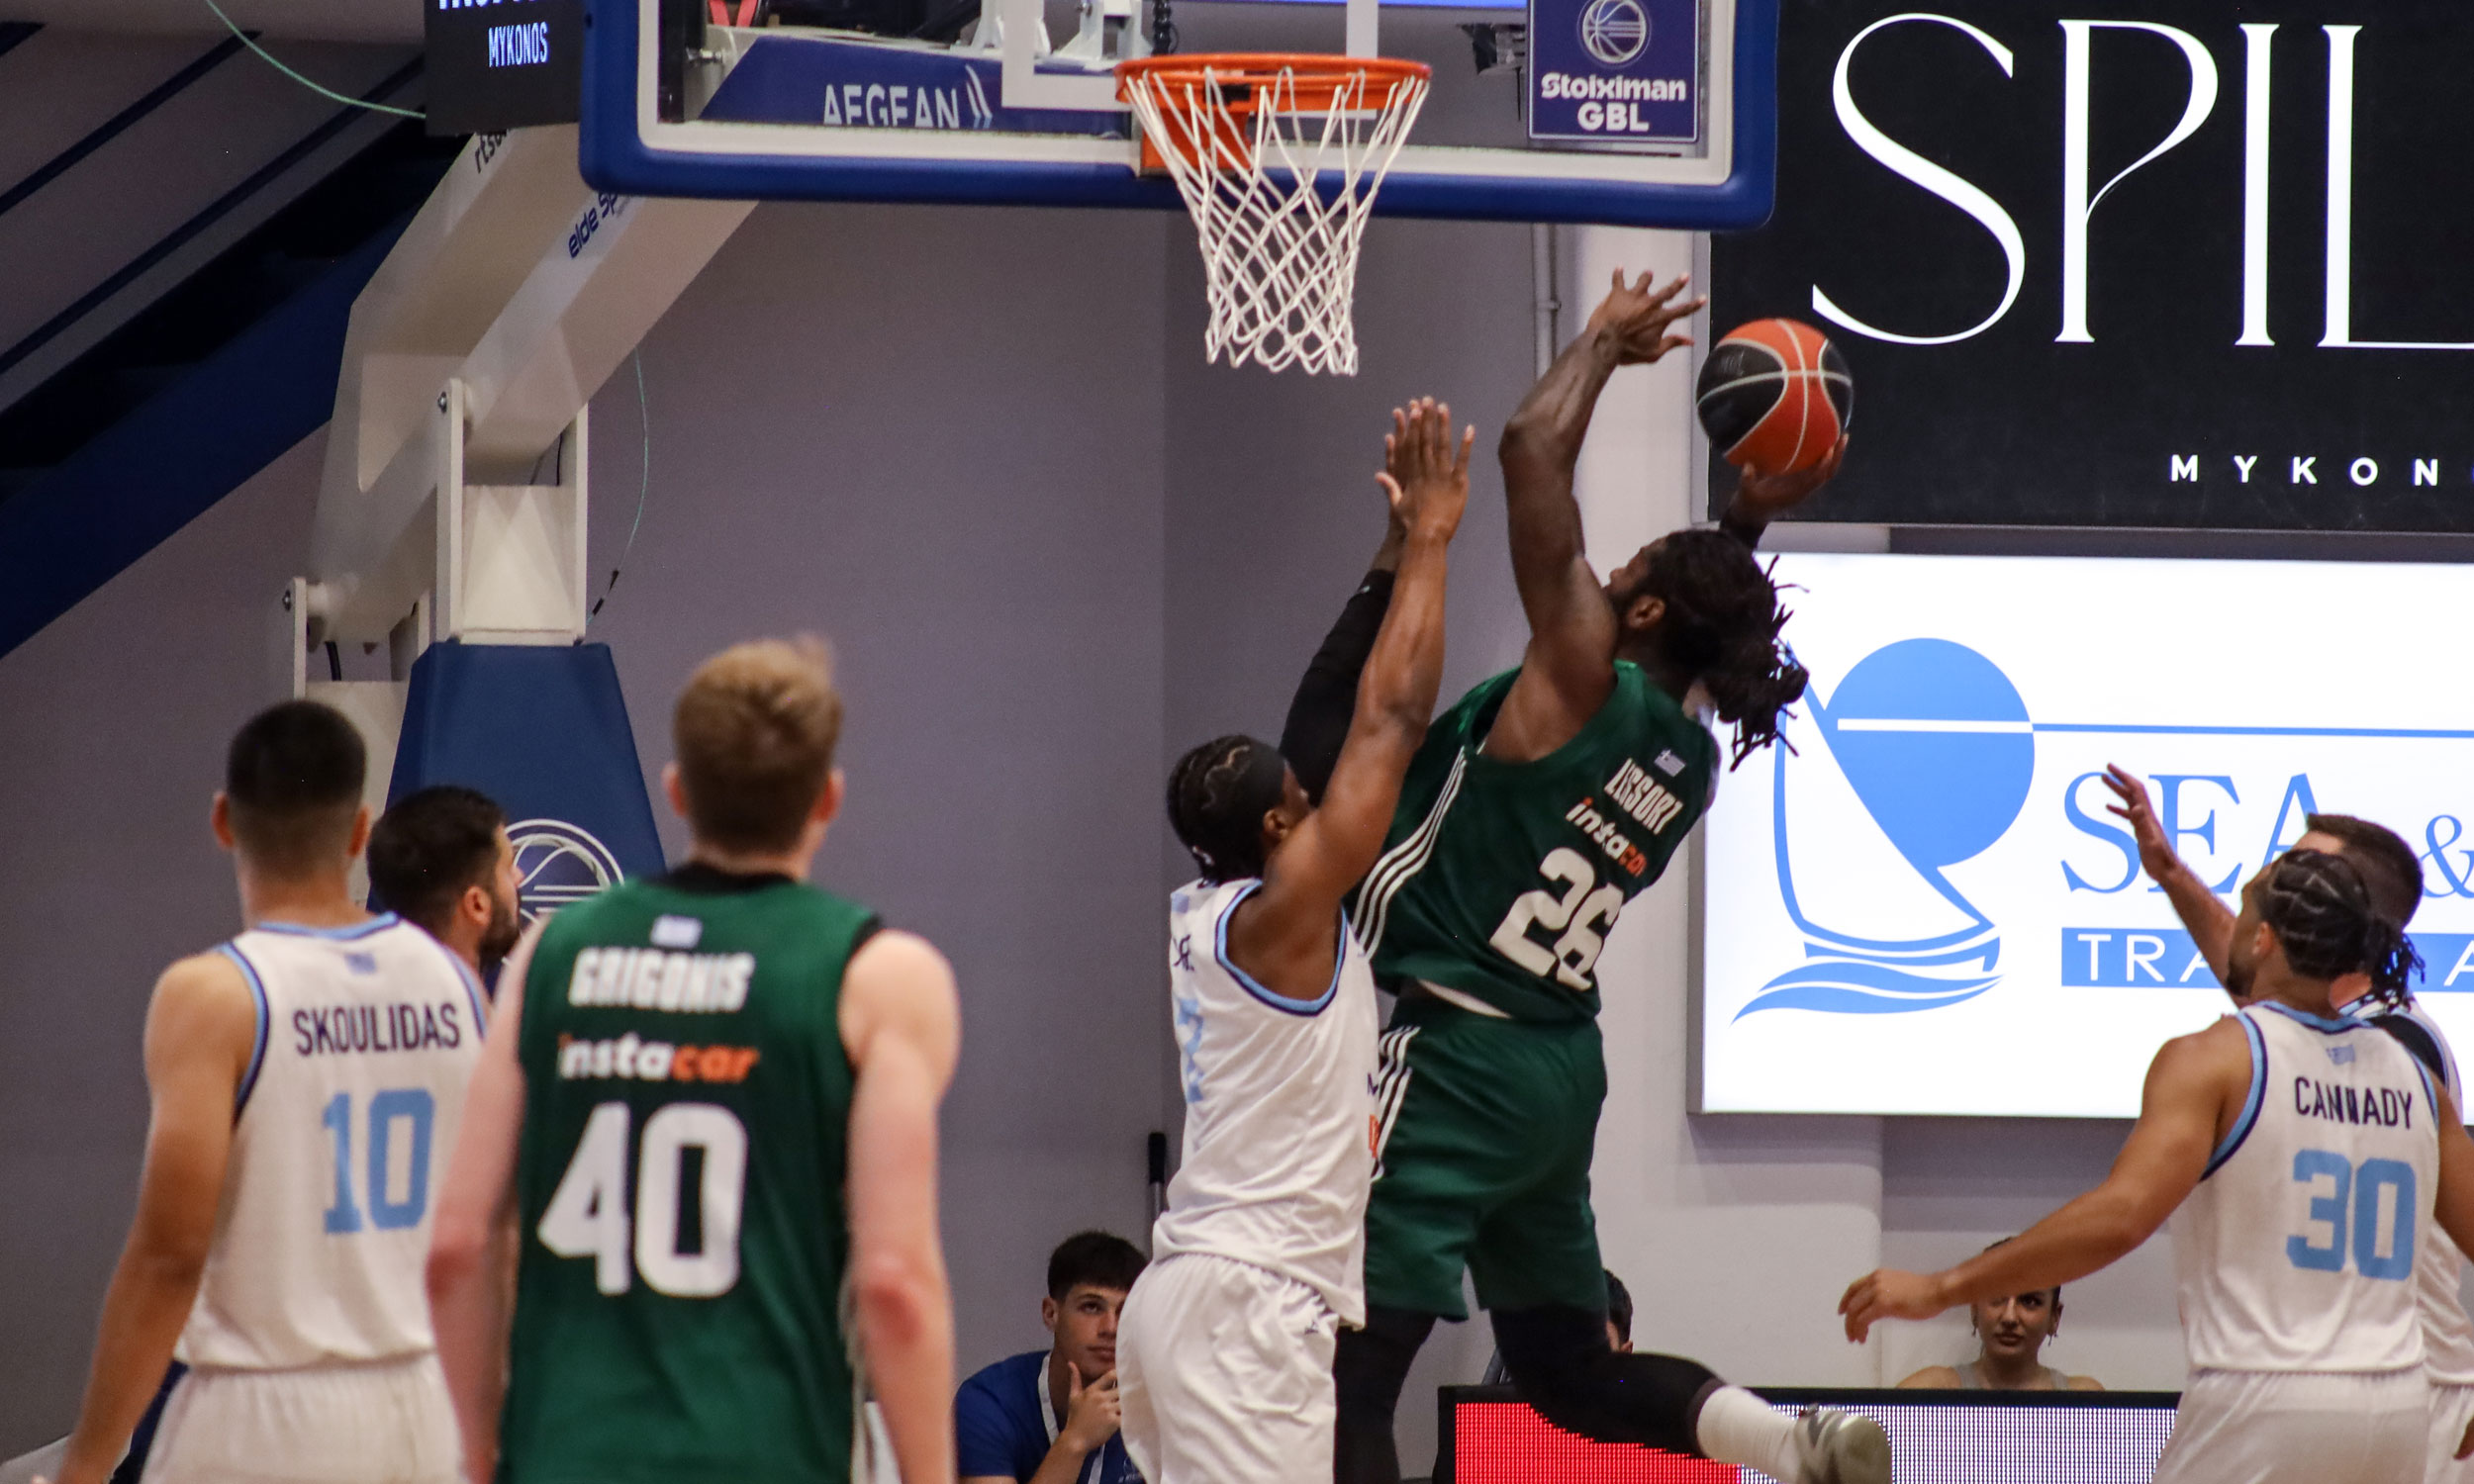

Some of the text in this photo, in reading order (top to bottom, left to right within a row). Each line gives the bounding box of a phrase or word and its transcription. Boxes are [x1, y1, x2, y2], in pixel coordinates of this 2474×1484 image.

[488, 21, 548, 67] MYKONOS
[1577, 103, 1650, 132] GBL
[1488, 847, 1624, 992] 26
[293, 1002, 461, 1057] SKOULIDAS
[558, 1033, 760, 1083] instacar
[323, 1087, 435, 1234] 10
[536, 1102, 748, 1297] 40
[2286, 1149, 2417, 1281] 30
